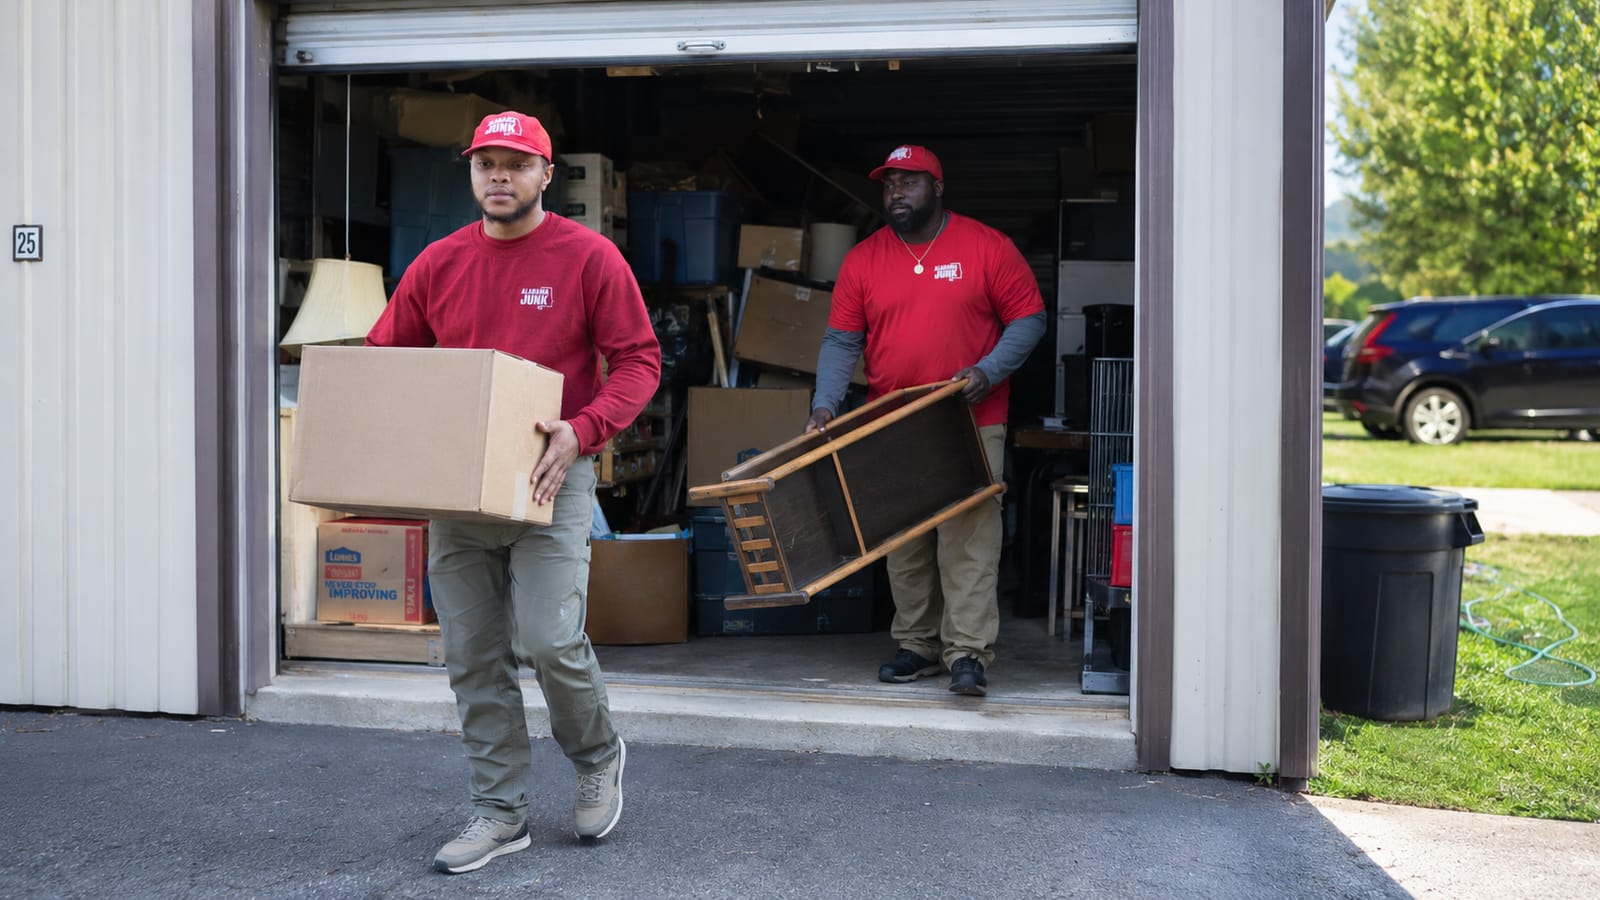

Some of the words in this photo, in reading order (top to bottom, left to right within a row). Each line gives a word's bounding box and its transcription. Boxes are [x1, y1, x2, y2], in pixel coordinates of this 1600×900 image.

[484, 121, 516, 135] JUNK
[17, 231, 36, 254] 25
[934, 269, 958, 279] JUNK
[520, 287, 549, 295] ALABAMA
[520, 294, 548, 305] JUNK
[329, 588, 398, 600] IMPROVING
